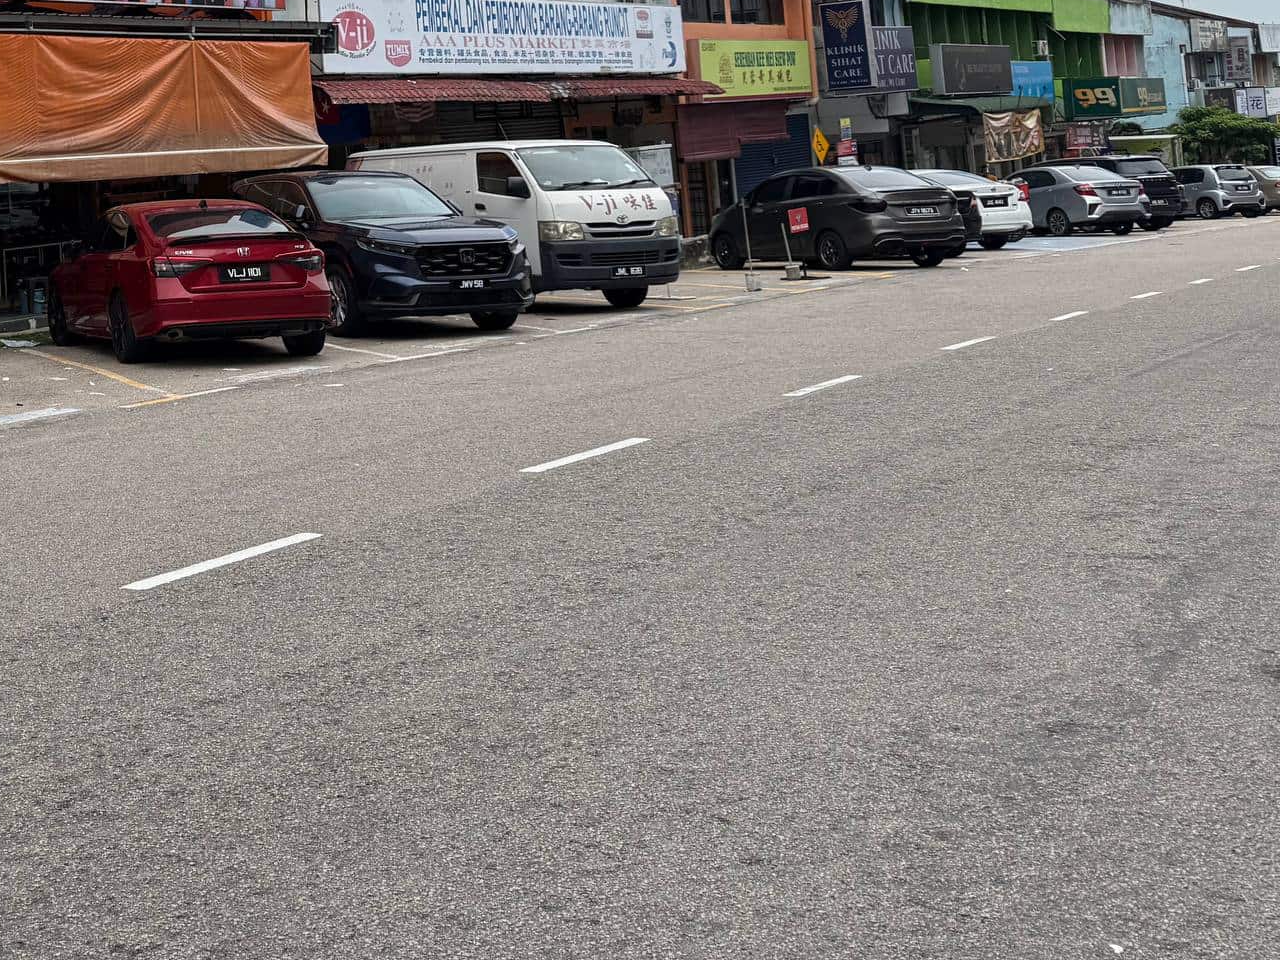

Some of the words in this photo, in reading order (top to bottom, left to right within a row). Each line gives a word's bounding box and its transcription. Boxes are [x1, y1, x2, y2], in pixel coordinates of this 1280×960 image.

[466, 0, 485, 34] DAN
[485, 0, 538, 36] PEMBORONG
[538, 2, 604, 37] BARANG-BARANG
[604, 6, 630, 38] RUNCIT
[420, 34, 456, 47] AAA
[463, 35, 505, 48] PLUS
[510, 36, 576, 49] MARKET
[826, 44, 865, 56] KLINIK
[831, 56, 863, 67] SIHAT
[888, 54, 915, 74] CARE
[834, 68, 863, 79] CARE
[1074, 87, 1116, 107] 99
[578, 193, 620, 216] V-ji
[227, 268, 247, 278] VLJ
